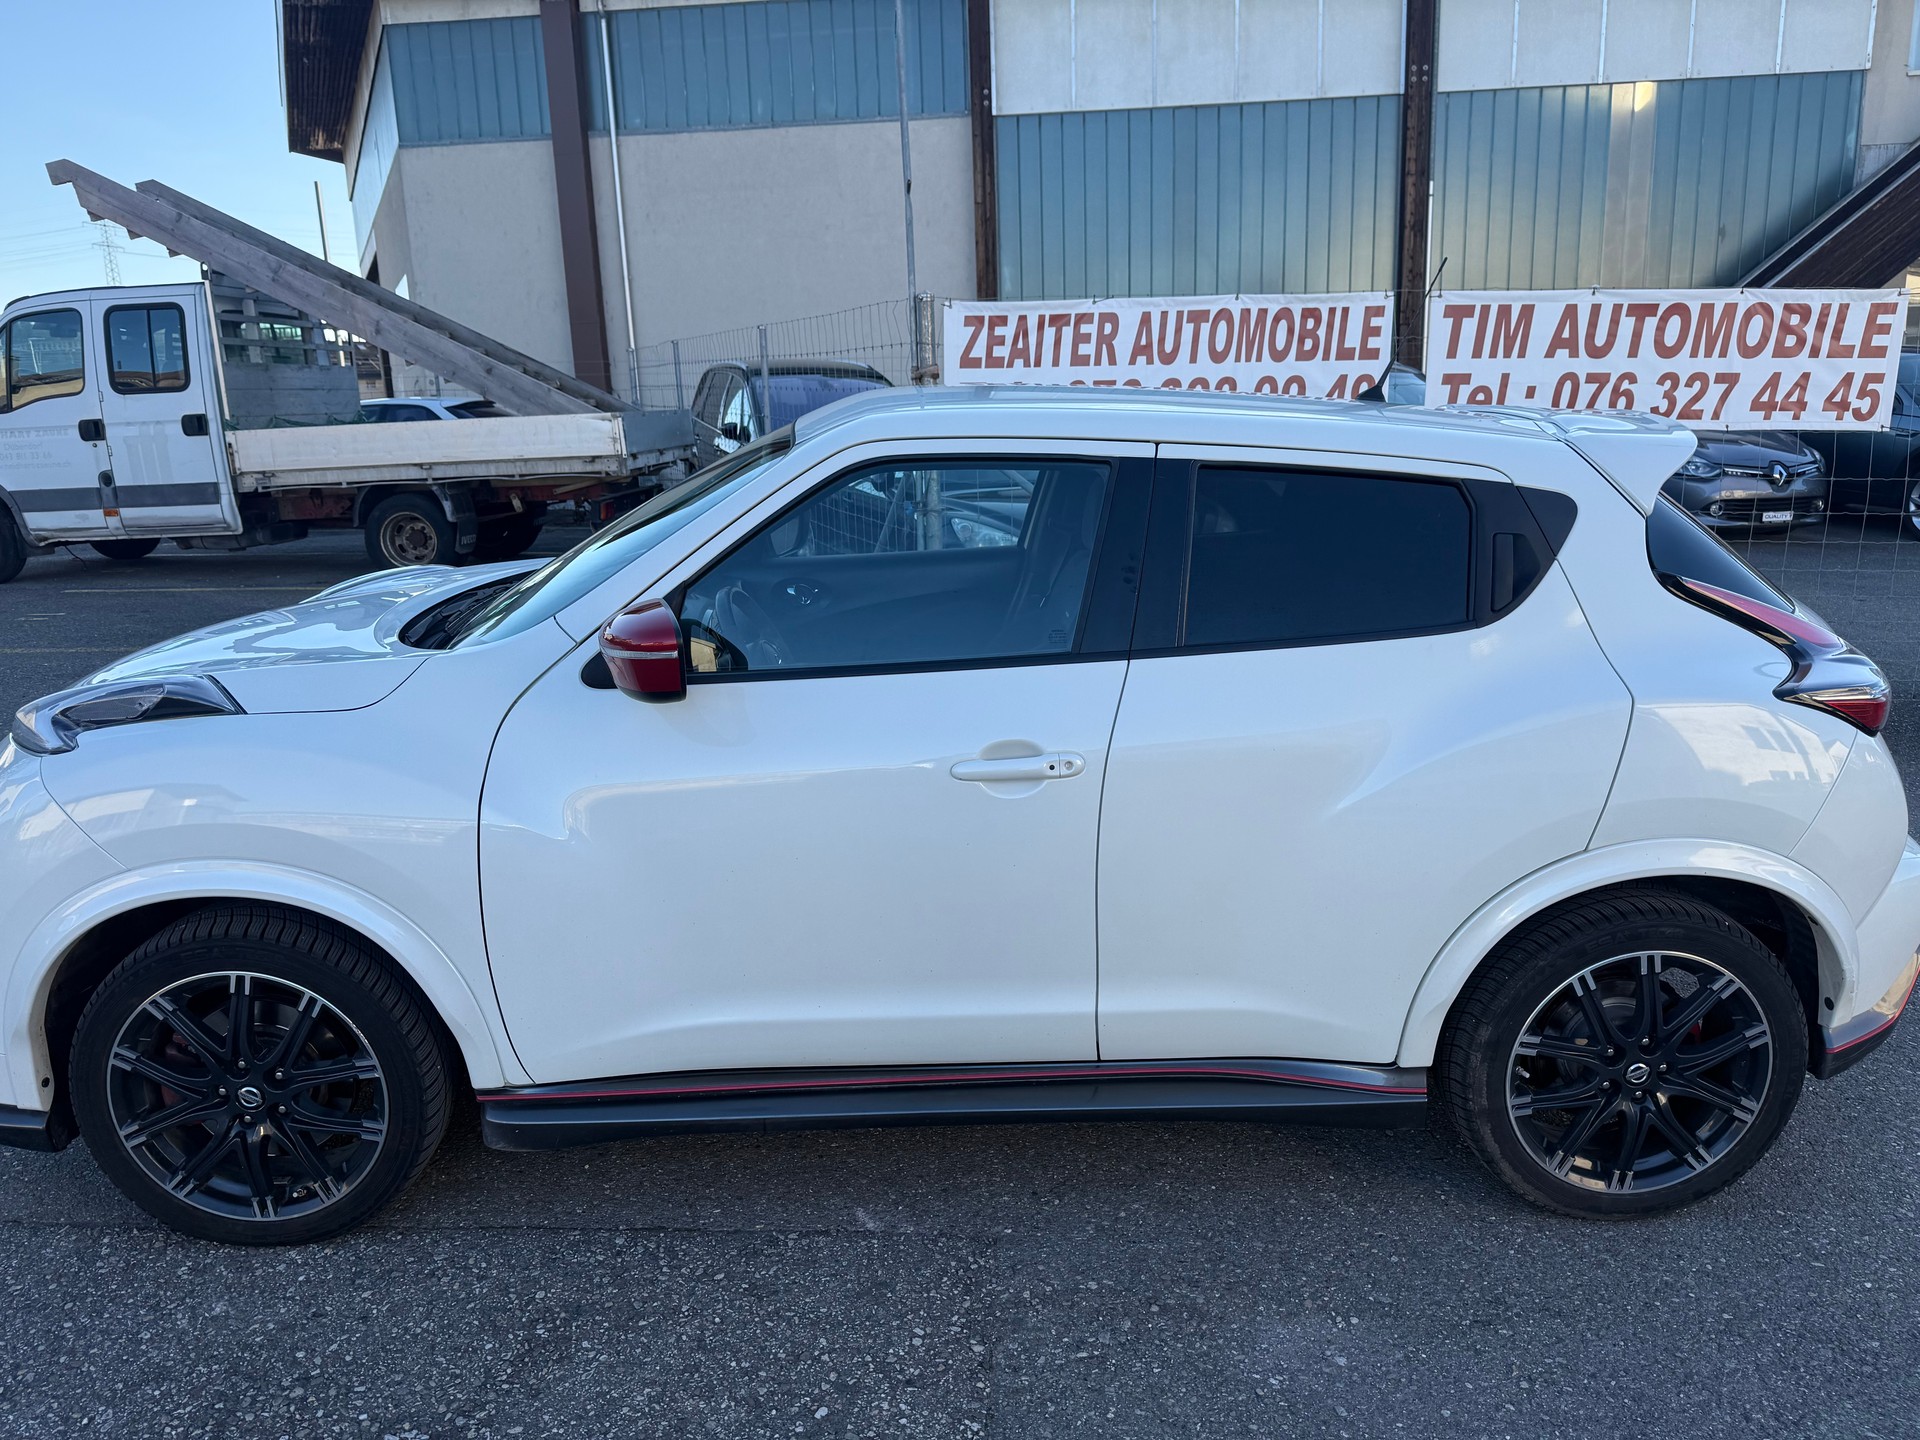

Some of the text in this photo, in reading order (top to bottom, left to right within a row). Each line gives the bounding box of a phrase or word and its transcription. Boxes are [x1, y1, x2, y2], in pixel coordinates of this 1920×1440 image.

[959, 305, 1386, 369] ZEAITER AUTOMOBILE
[1443, 302, 1898, 359] TIM AUTOMOBILE
[1551, 372, 1638, 410] 076
[1650, 371, 1741, 421] 327
[1750, 371, 1811, 421] 44
[1822, 372, 1886, 422] 45
